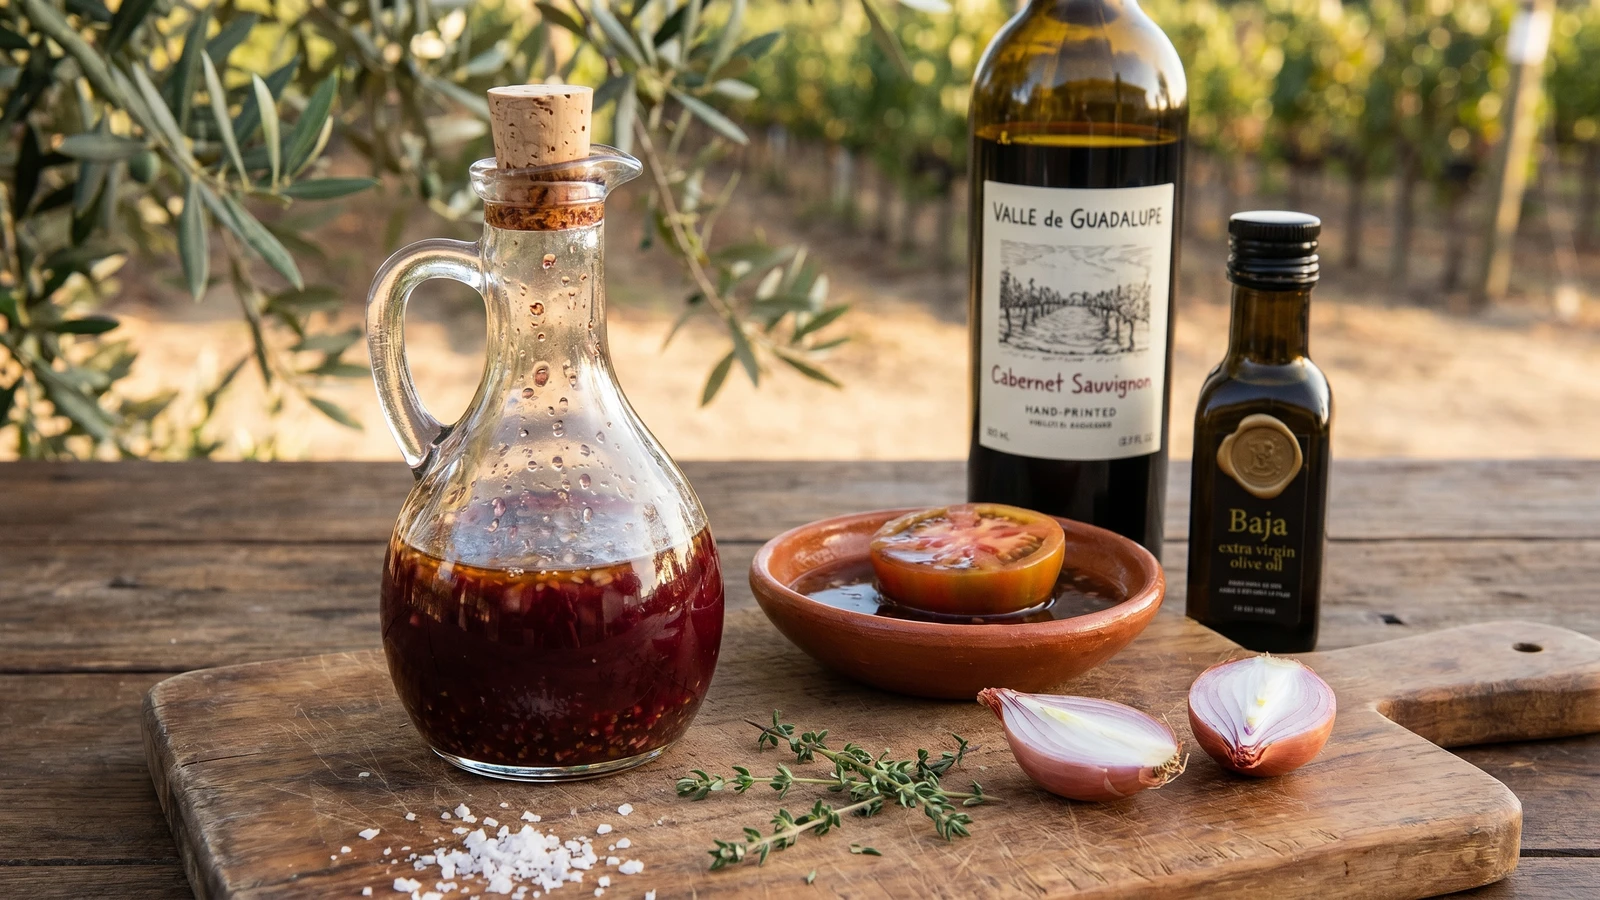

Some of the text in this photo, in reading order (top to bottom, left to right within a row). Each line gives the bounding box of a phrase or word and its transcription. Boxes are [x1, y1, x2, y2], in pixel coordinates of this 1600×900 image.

[993, 201, 1163, 229] VALLE de GUADALUPE
[991, 364, 1151, 399] Cabernet Sauvignon
[1025, 405, 1117, 417] HAND-PRINTED
[1228, 508, 1288, 542] Baja
[1218, 543, 1296, 560] extra virgin
[1230, 556, 1262, 570] olive
